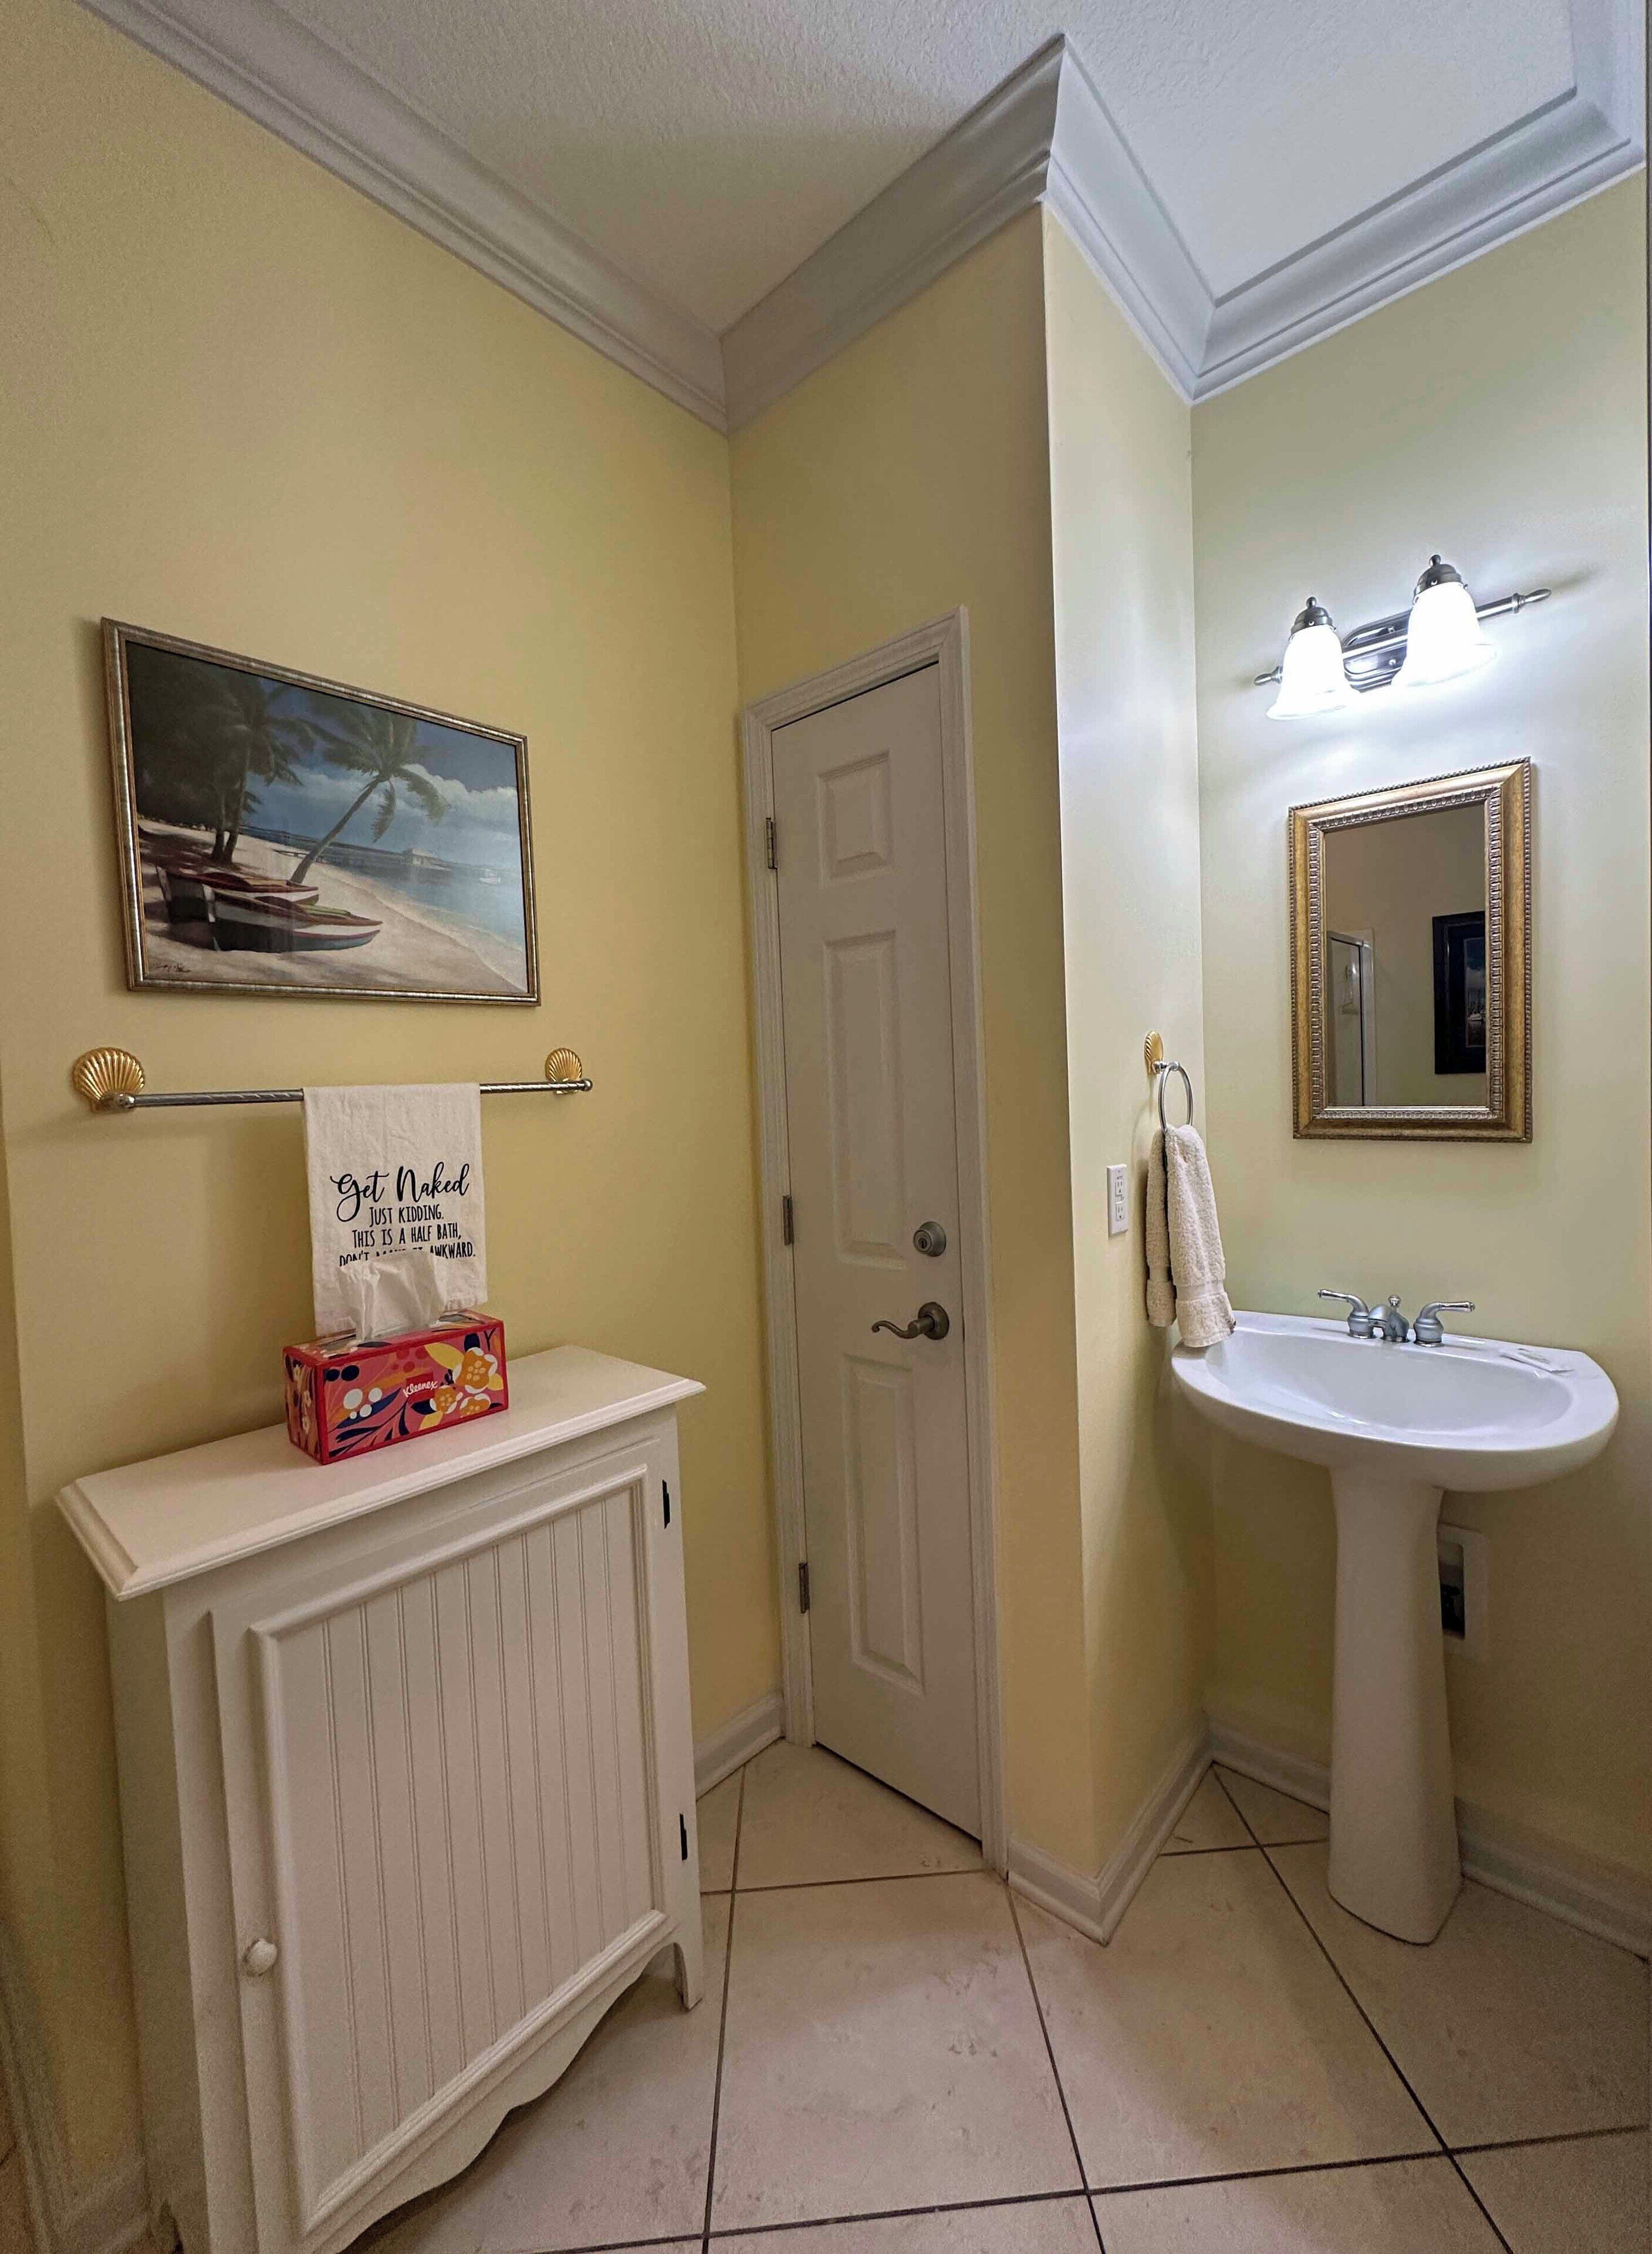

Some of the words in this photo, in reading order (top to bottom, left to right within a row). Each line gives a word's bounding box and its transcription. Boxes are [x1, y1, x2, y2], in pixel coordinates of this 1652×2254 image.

[330, 1170, 389, 1222] Get
[397, 1162, 469, 1203] Naked
[369, 1207, 393, 1227] JUST
[398, 1204, 444, 1223] KIDDING.
[352, 1229, 374, 1248] THIS
[381, 1229, 393, 1246] IS
[399, 1227, 406, 1244] A
[411, 1226, 432, 1243] HALF
[437, 1223, 461, 1240] BATH,
[403, 1381, 438, 1397] Kleenex
